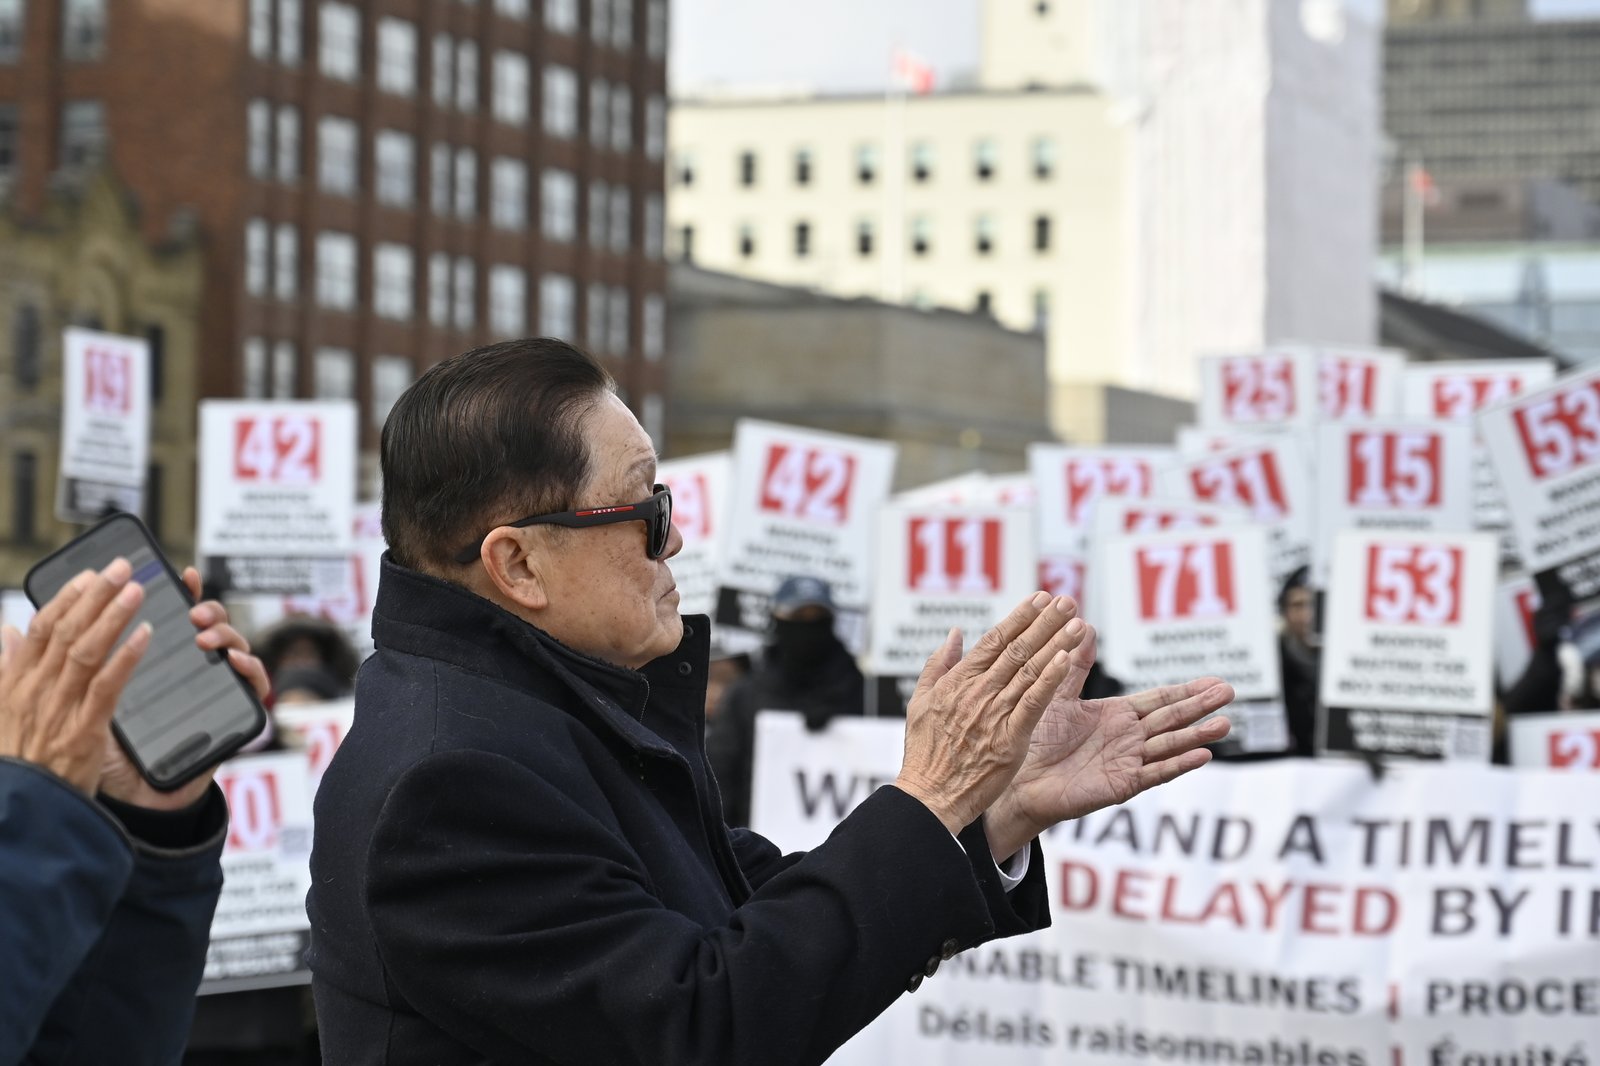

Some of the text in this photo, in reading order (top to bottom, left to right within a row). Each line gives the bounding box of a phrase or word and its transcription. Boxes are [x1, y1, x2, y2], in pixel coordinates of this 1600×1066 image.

[1220, 360, 1292, 420] 25
[236, 418, 321, 482] 42
[1518, 382, 1600, 475] 53
[762, 443, 853, 525] 42
[1350, 432, 1440, 506] 15
[908, 518, 1000, 592] 11
[1137, 541, 1236, 621] 71
[1367, 545, 1461, 625] 53
[795, 767, 897, 820] W
[1277, 814, 1326, 865] A
[1352, 817, 1600, 869] TIMEL
[1062, 861, 1402, 937] DELAYED
[1431, 885, 1531, 938] BY
[1111, 956, 1361, 1015] TIMELINES
[918, 1004, 1054, 1045] Délais
